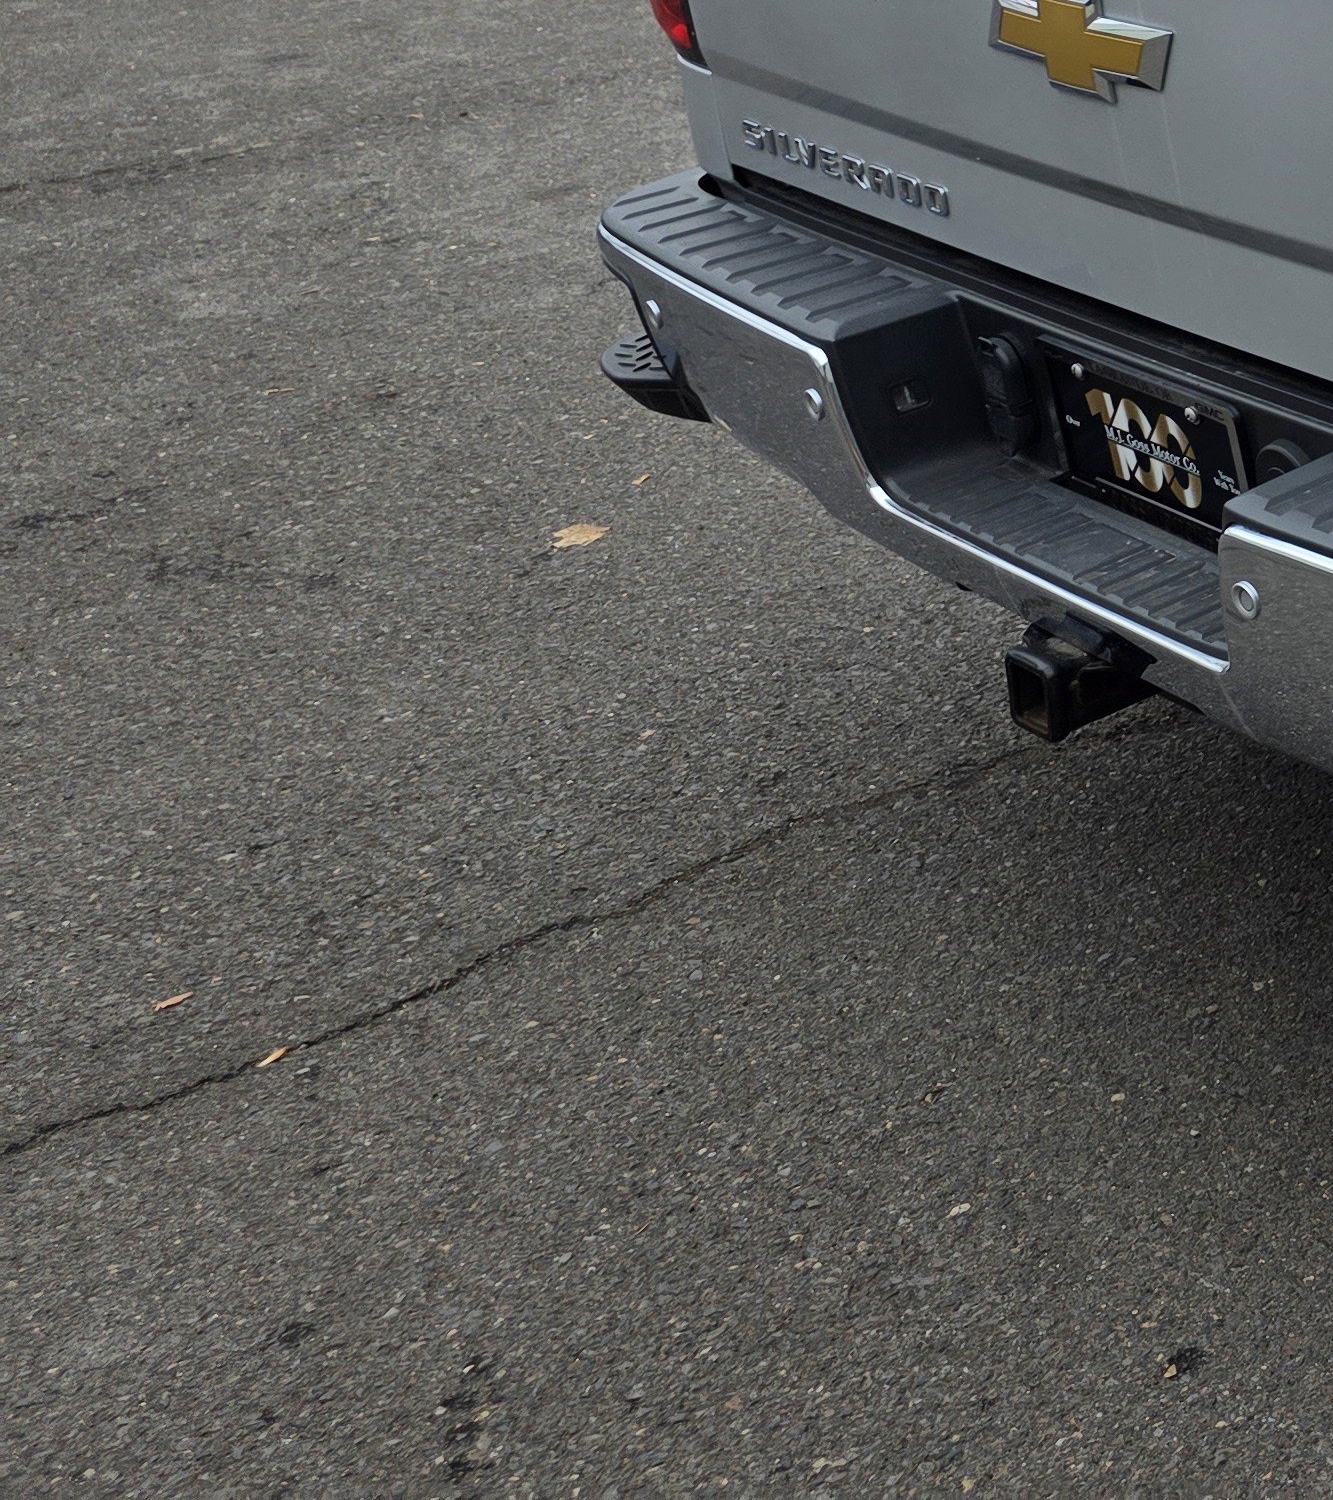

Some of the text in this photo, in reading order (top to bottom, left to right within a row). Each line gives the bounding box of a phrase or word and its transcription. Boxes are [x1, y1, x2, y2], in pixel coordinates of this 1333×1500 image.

[742, 118, 950, 217] SILVERADO
[1085, 388, 1203, 509] 100
[1126, 432, 1150, 454] Goss
[1151, 441, 1181, 466] Motor
